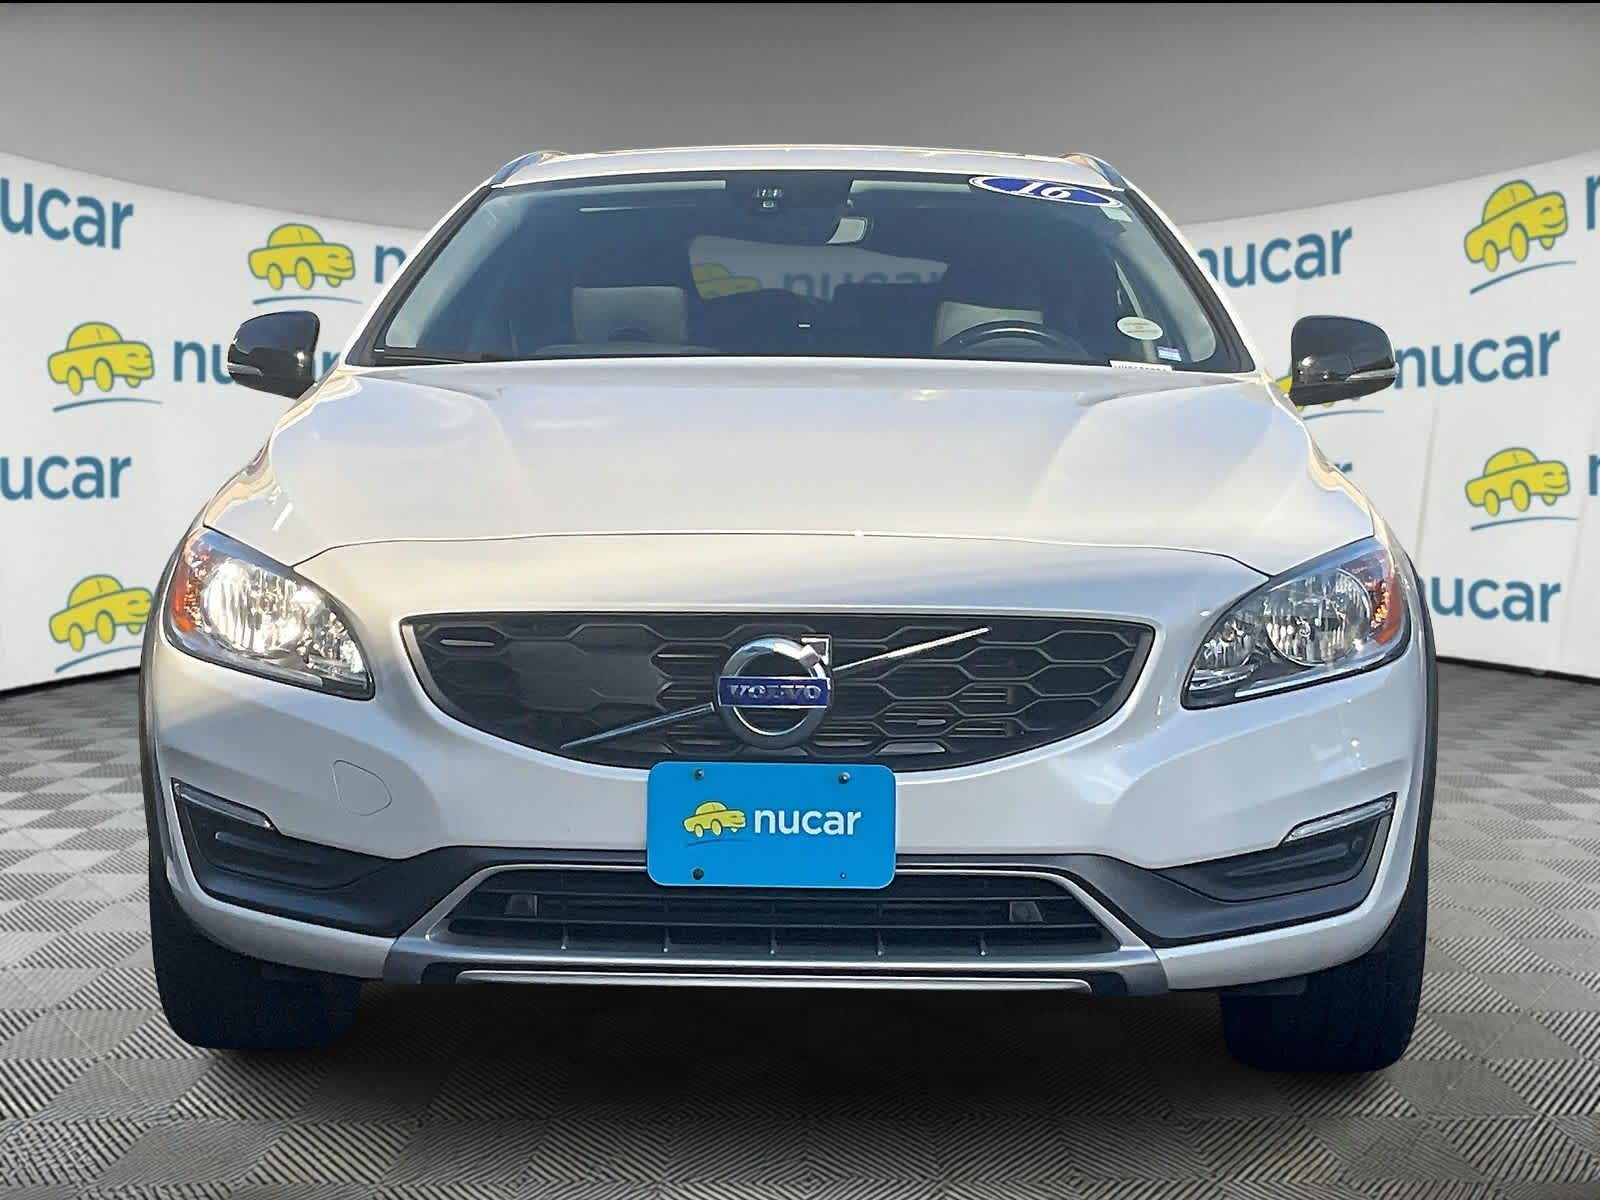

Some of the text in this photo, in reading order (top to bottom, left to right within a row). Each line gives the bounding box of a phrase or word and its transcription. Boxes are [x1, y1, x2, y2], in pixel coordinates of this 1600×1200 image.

[1009, 181, 1071, 199] 16
[1394, 330, 1561, 389] nucar
[1419, 576, 1561, 623] ucar
[727, 684, 822, 700] VOLVO
[754, 808, 862, 836] nucar
